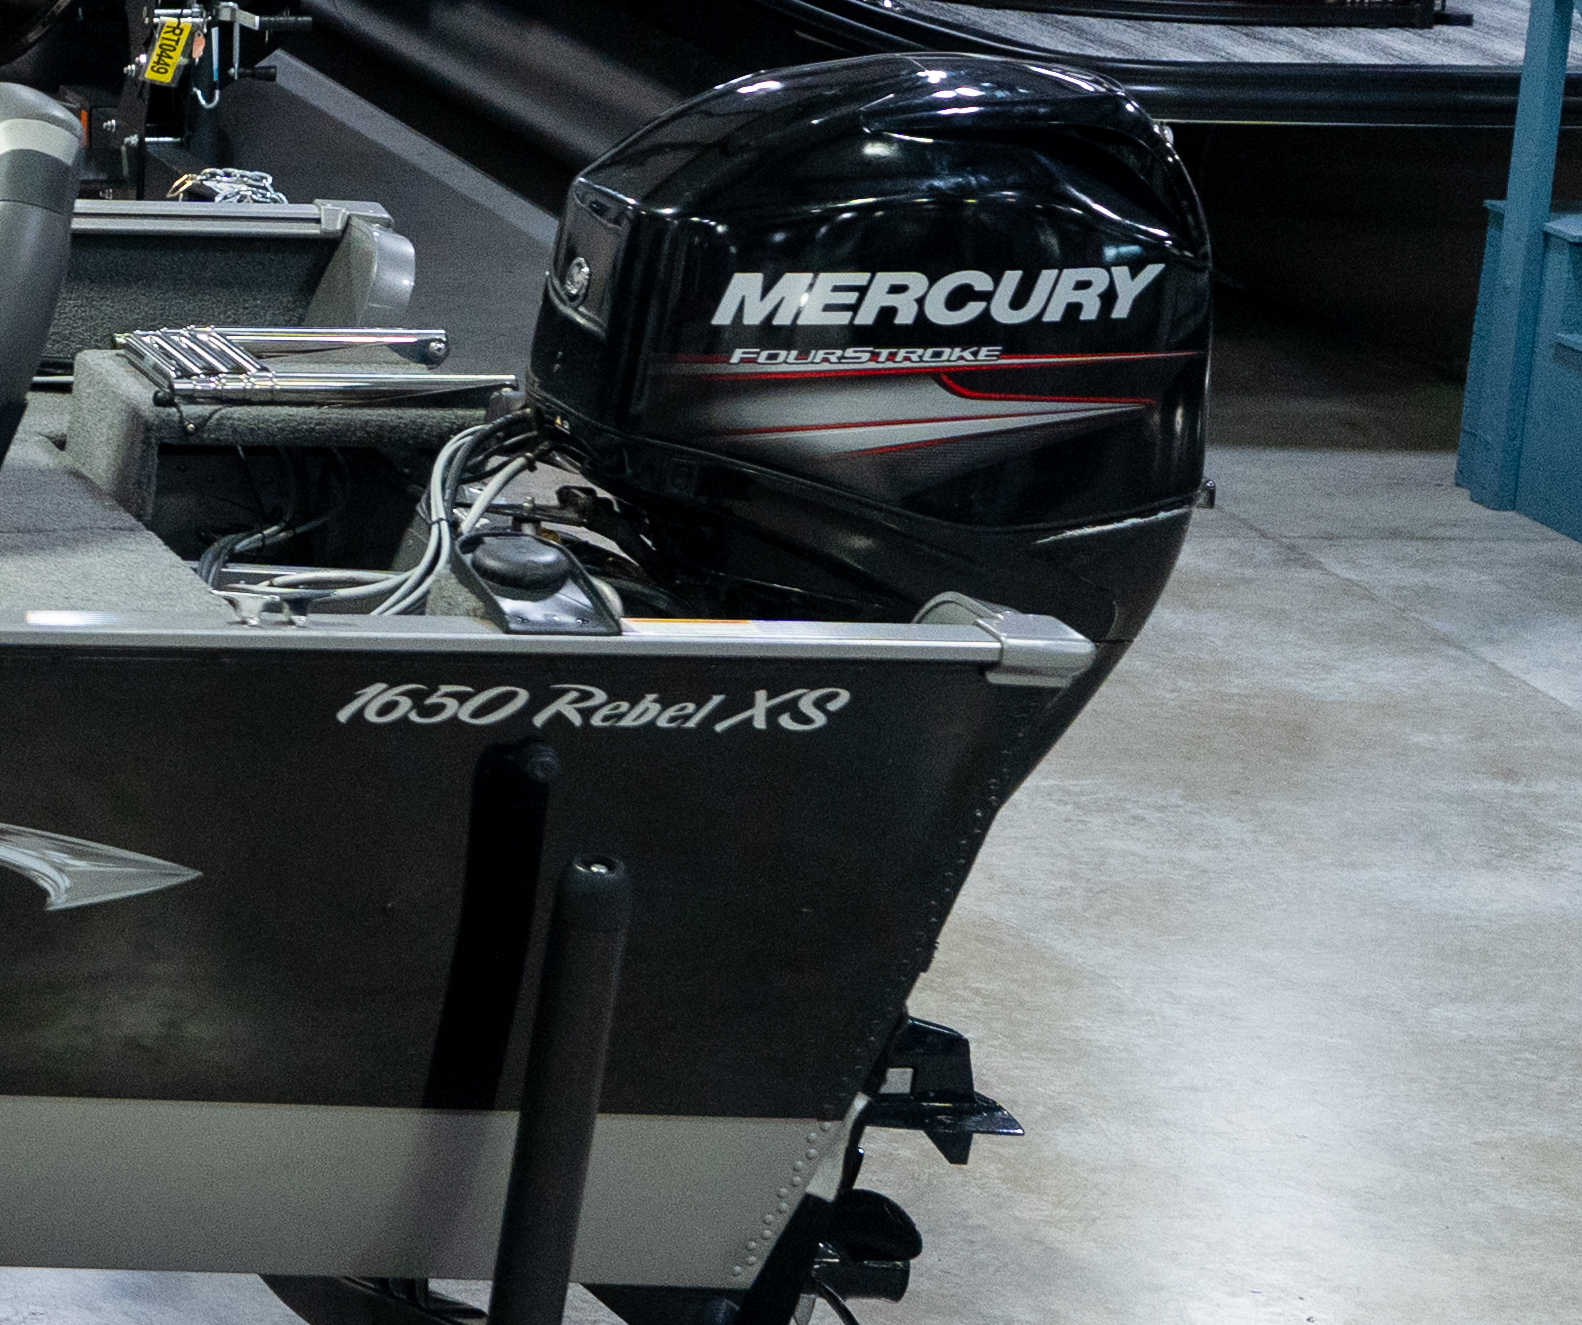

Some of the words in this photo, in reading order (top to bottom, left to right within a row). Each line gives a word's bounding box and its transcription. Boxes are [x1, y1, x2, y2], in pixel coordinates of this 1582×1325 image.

[150, 25, 184, 75] RT0449
[710, 263, 1166, 327] MERCURY
[729, 345, 1003, 365] FOURSTROKE
[335, 682, 530, 725] 1650
[532, 684, 725, 729] Rebel
[713, 687, 851, 733] XS
